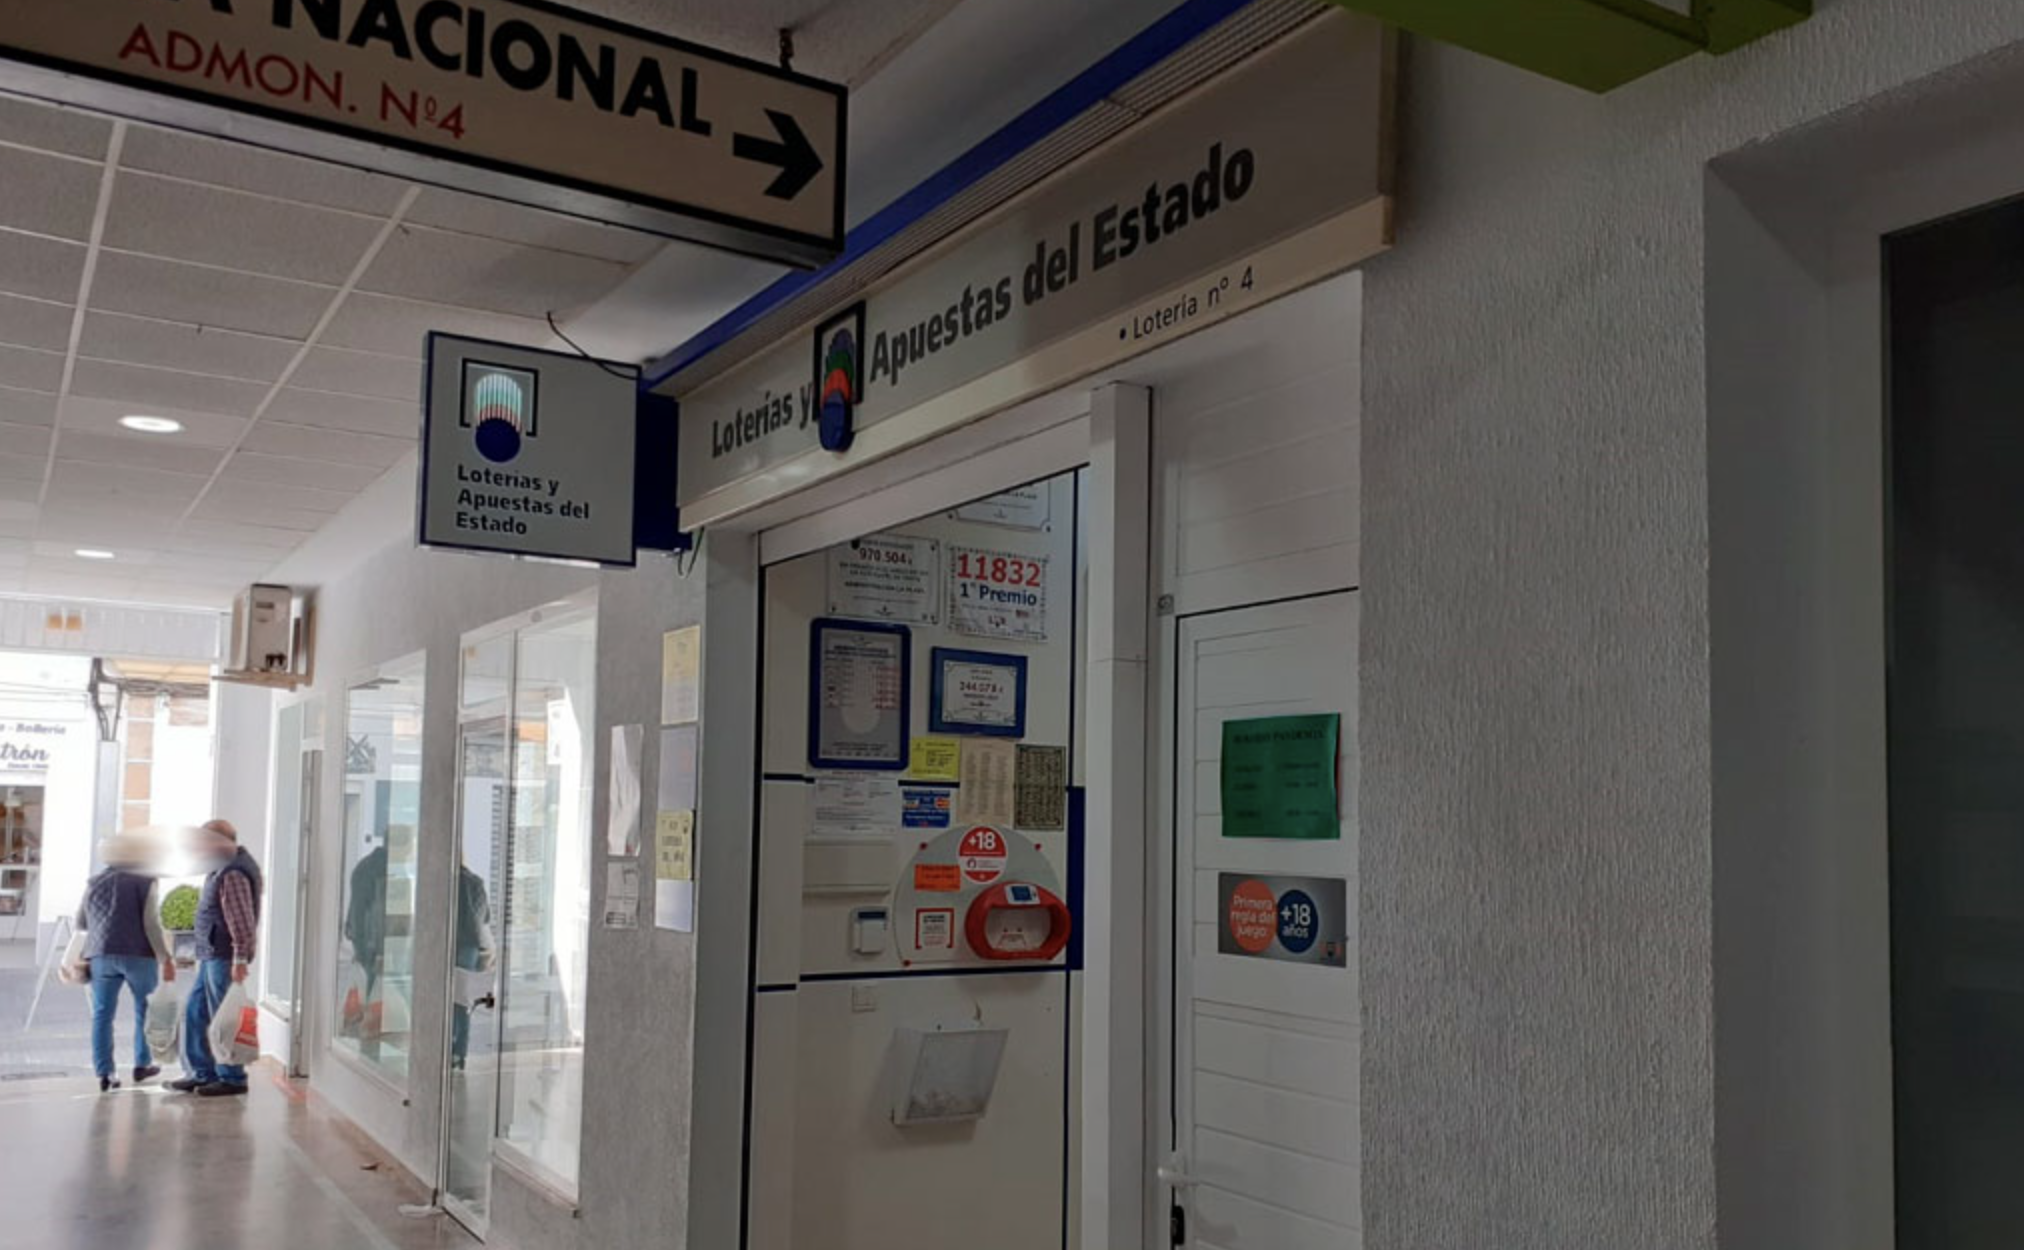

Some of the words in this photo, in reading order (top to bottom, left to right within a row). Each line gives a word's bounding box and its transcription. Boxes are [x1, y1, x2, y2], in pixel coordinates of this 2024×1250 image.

[119, 23, 357, 113] ADMON.
[799, 381, 813, 431] y
[868, 276, 1012, 385] Apuestas
[1021, 219, 1080, 305] del
[1092, 141, 1255, 272] Estado
[1133, 290, 1197, 340] Lotería
[1240, 265, 1254, 291] 4
[547, 479, 560, 497] y
[457, 488, 554, 515] Apuestas
[559, 500, 590, 519] del
[456, 511, 528, 535] Estado
[957, 552, 1041, 587] 11832
[979, 584, 1038, 607] Premio
[968, 831, 996, 850] +18
[1233, 894, 1273, 910] Primera
[1231, 911, 1257, 926] regla
[1259, 911, 1275, 924] del
[1280, 902, 1311, 926] +18
[1237, 924, 1267, 940] juego
[1282, 923, 1309, 939] años
